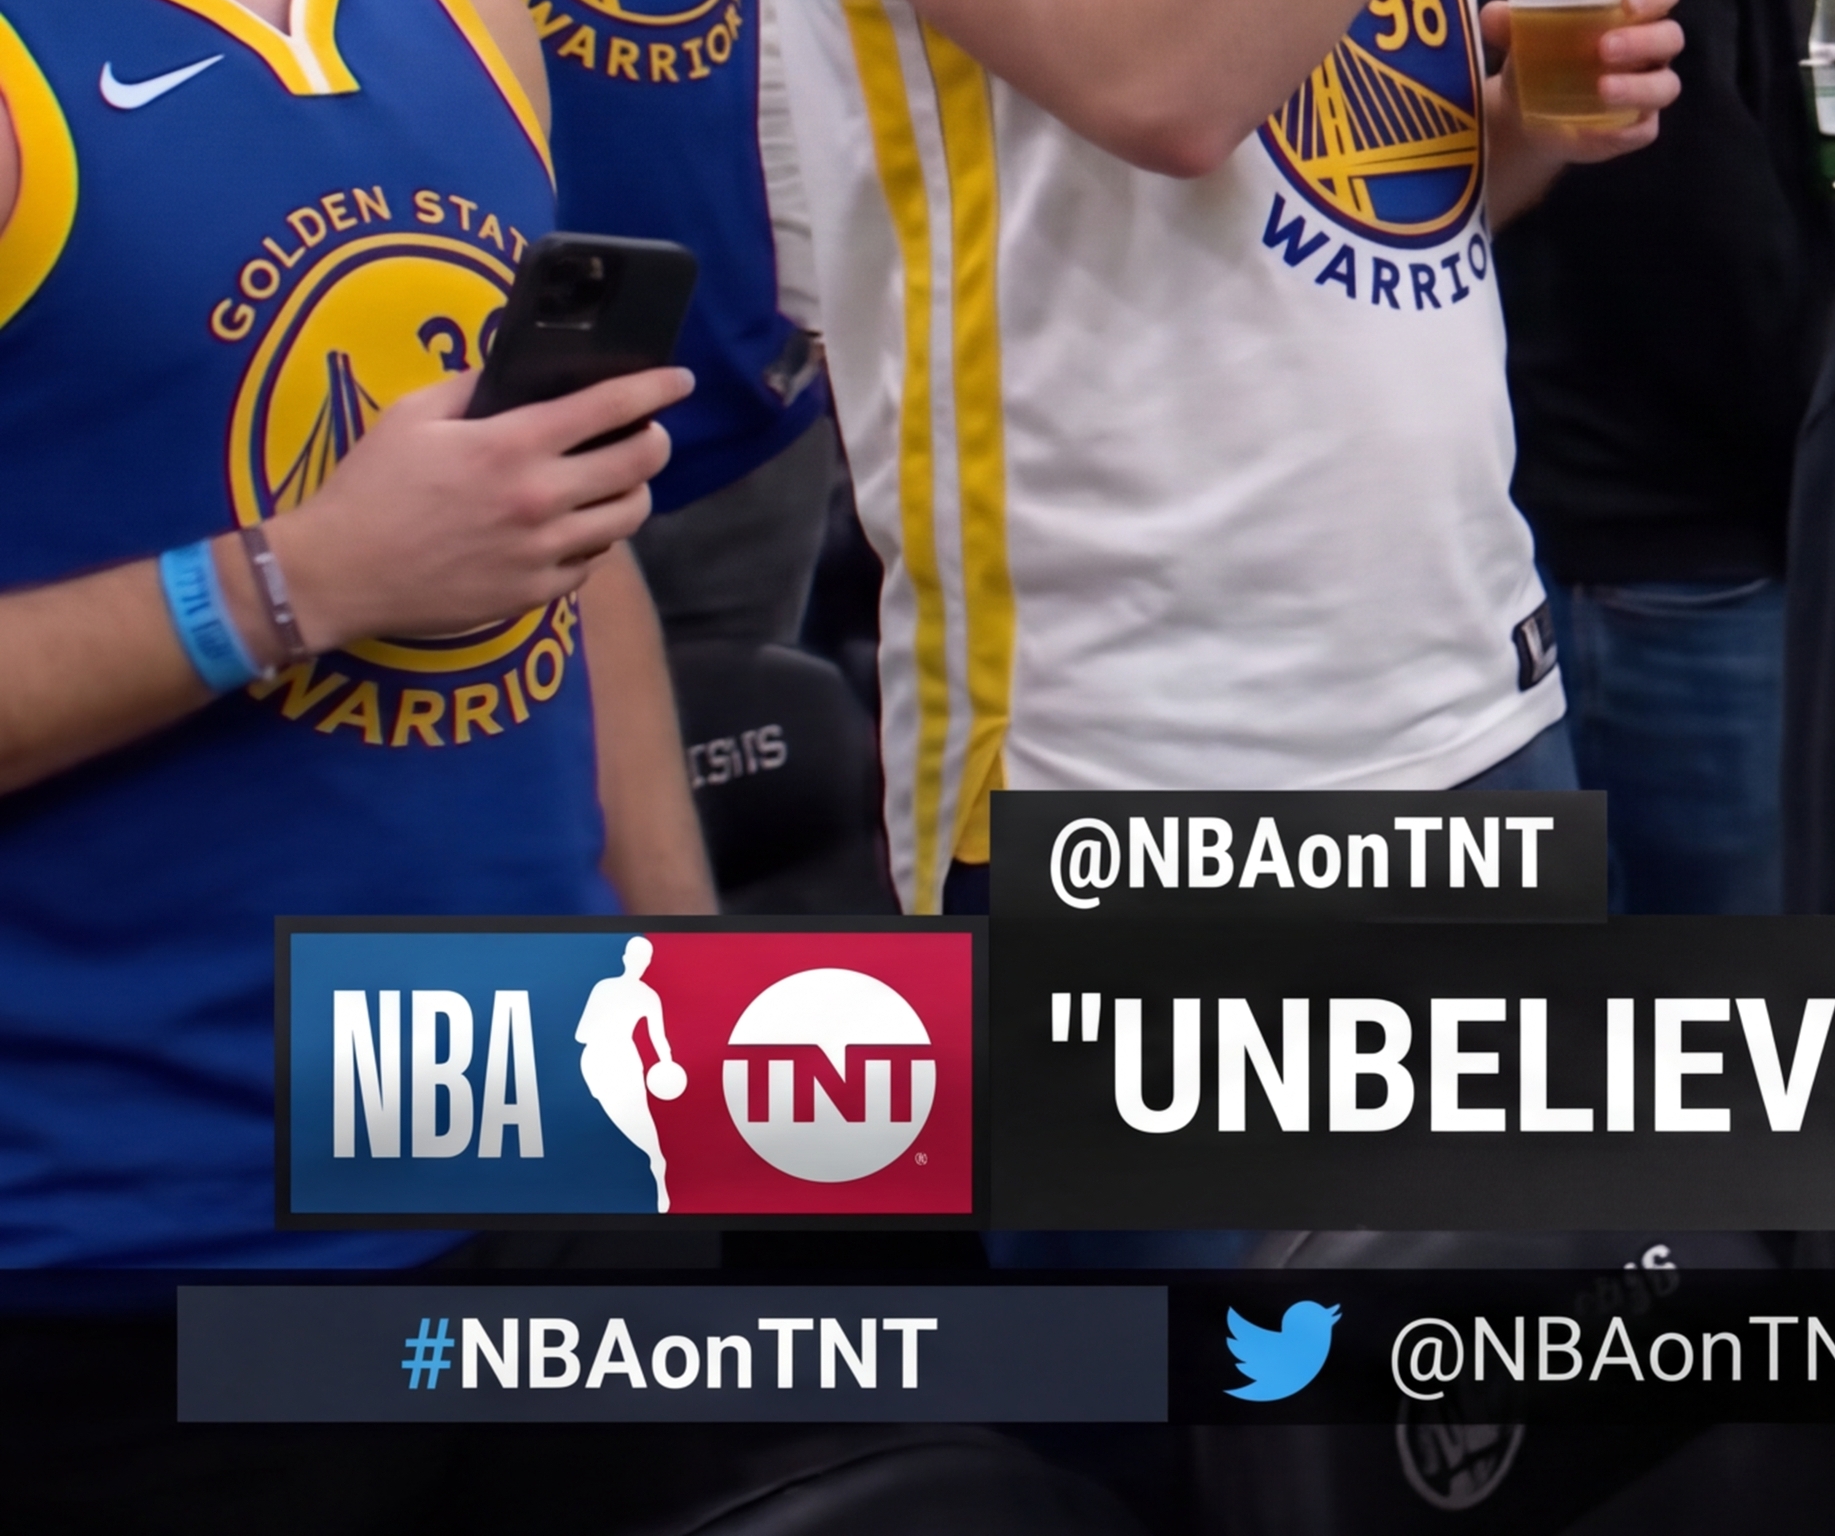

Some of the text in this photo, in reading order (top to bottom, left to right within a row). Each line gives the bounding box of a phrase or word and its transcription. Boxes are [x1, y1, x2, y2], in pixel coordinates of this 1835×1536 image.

[210, 186, 530, 342] GOLDEN STAT
[1262, 191, 1491, 311] WARRIO
[247, 590, 578, 747] WARRIOR
